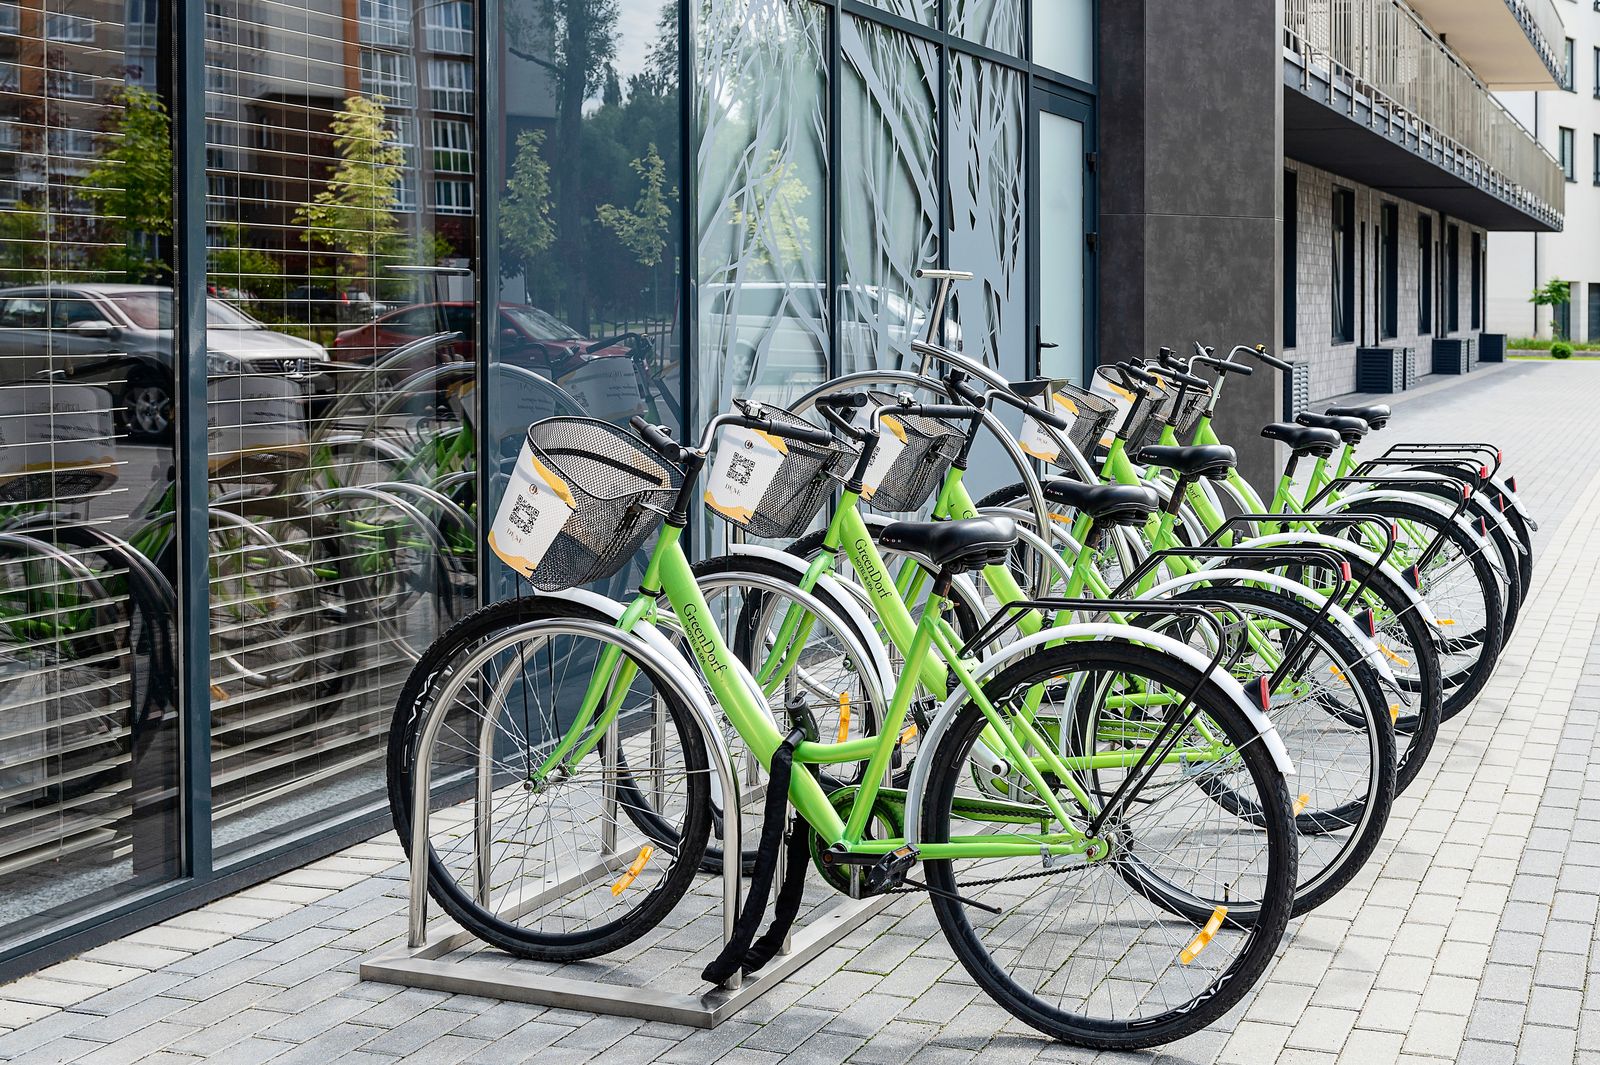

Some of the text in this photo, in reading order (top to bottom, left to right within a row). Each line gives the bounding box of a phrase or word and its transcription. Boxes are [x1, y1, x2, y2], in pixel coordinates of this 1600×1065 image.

[854, 538, 893, 599] GreenDorf
[854, 556, 865, 576] HOTEL
[866, 581, 874, 592] SPA
[683, 603, 728, 673] GreenDorf
[684, 625, 697, 647] HOTEL
[698, 653, 706, 665] SPA
